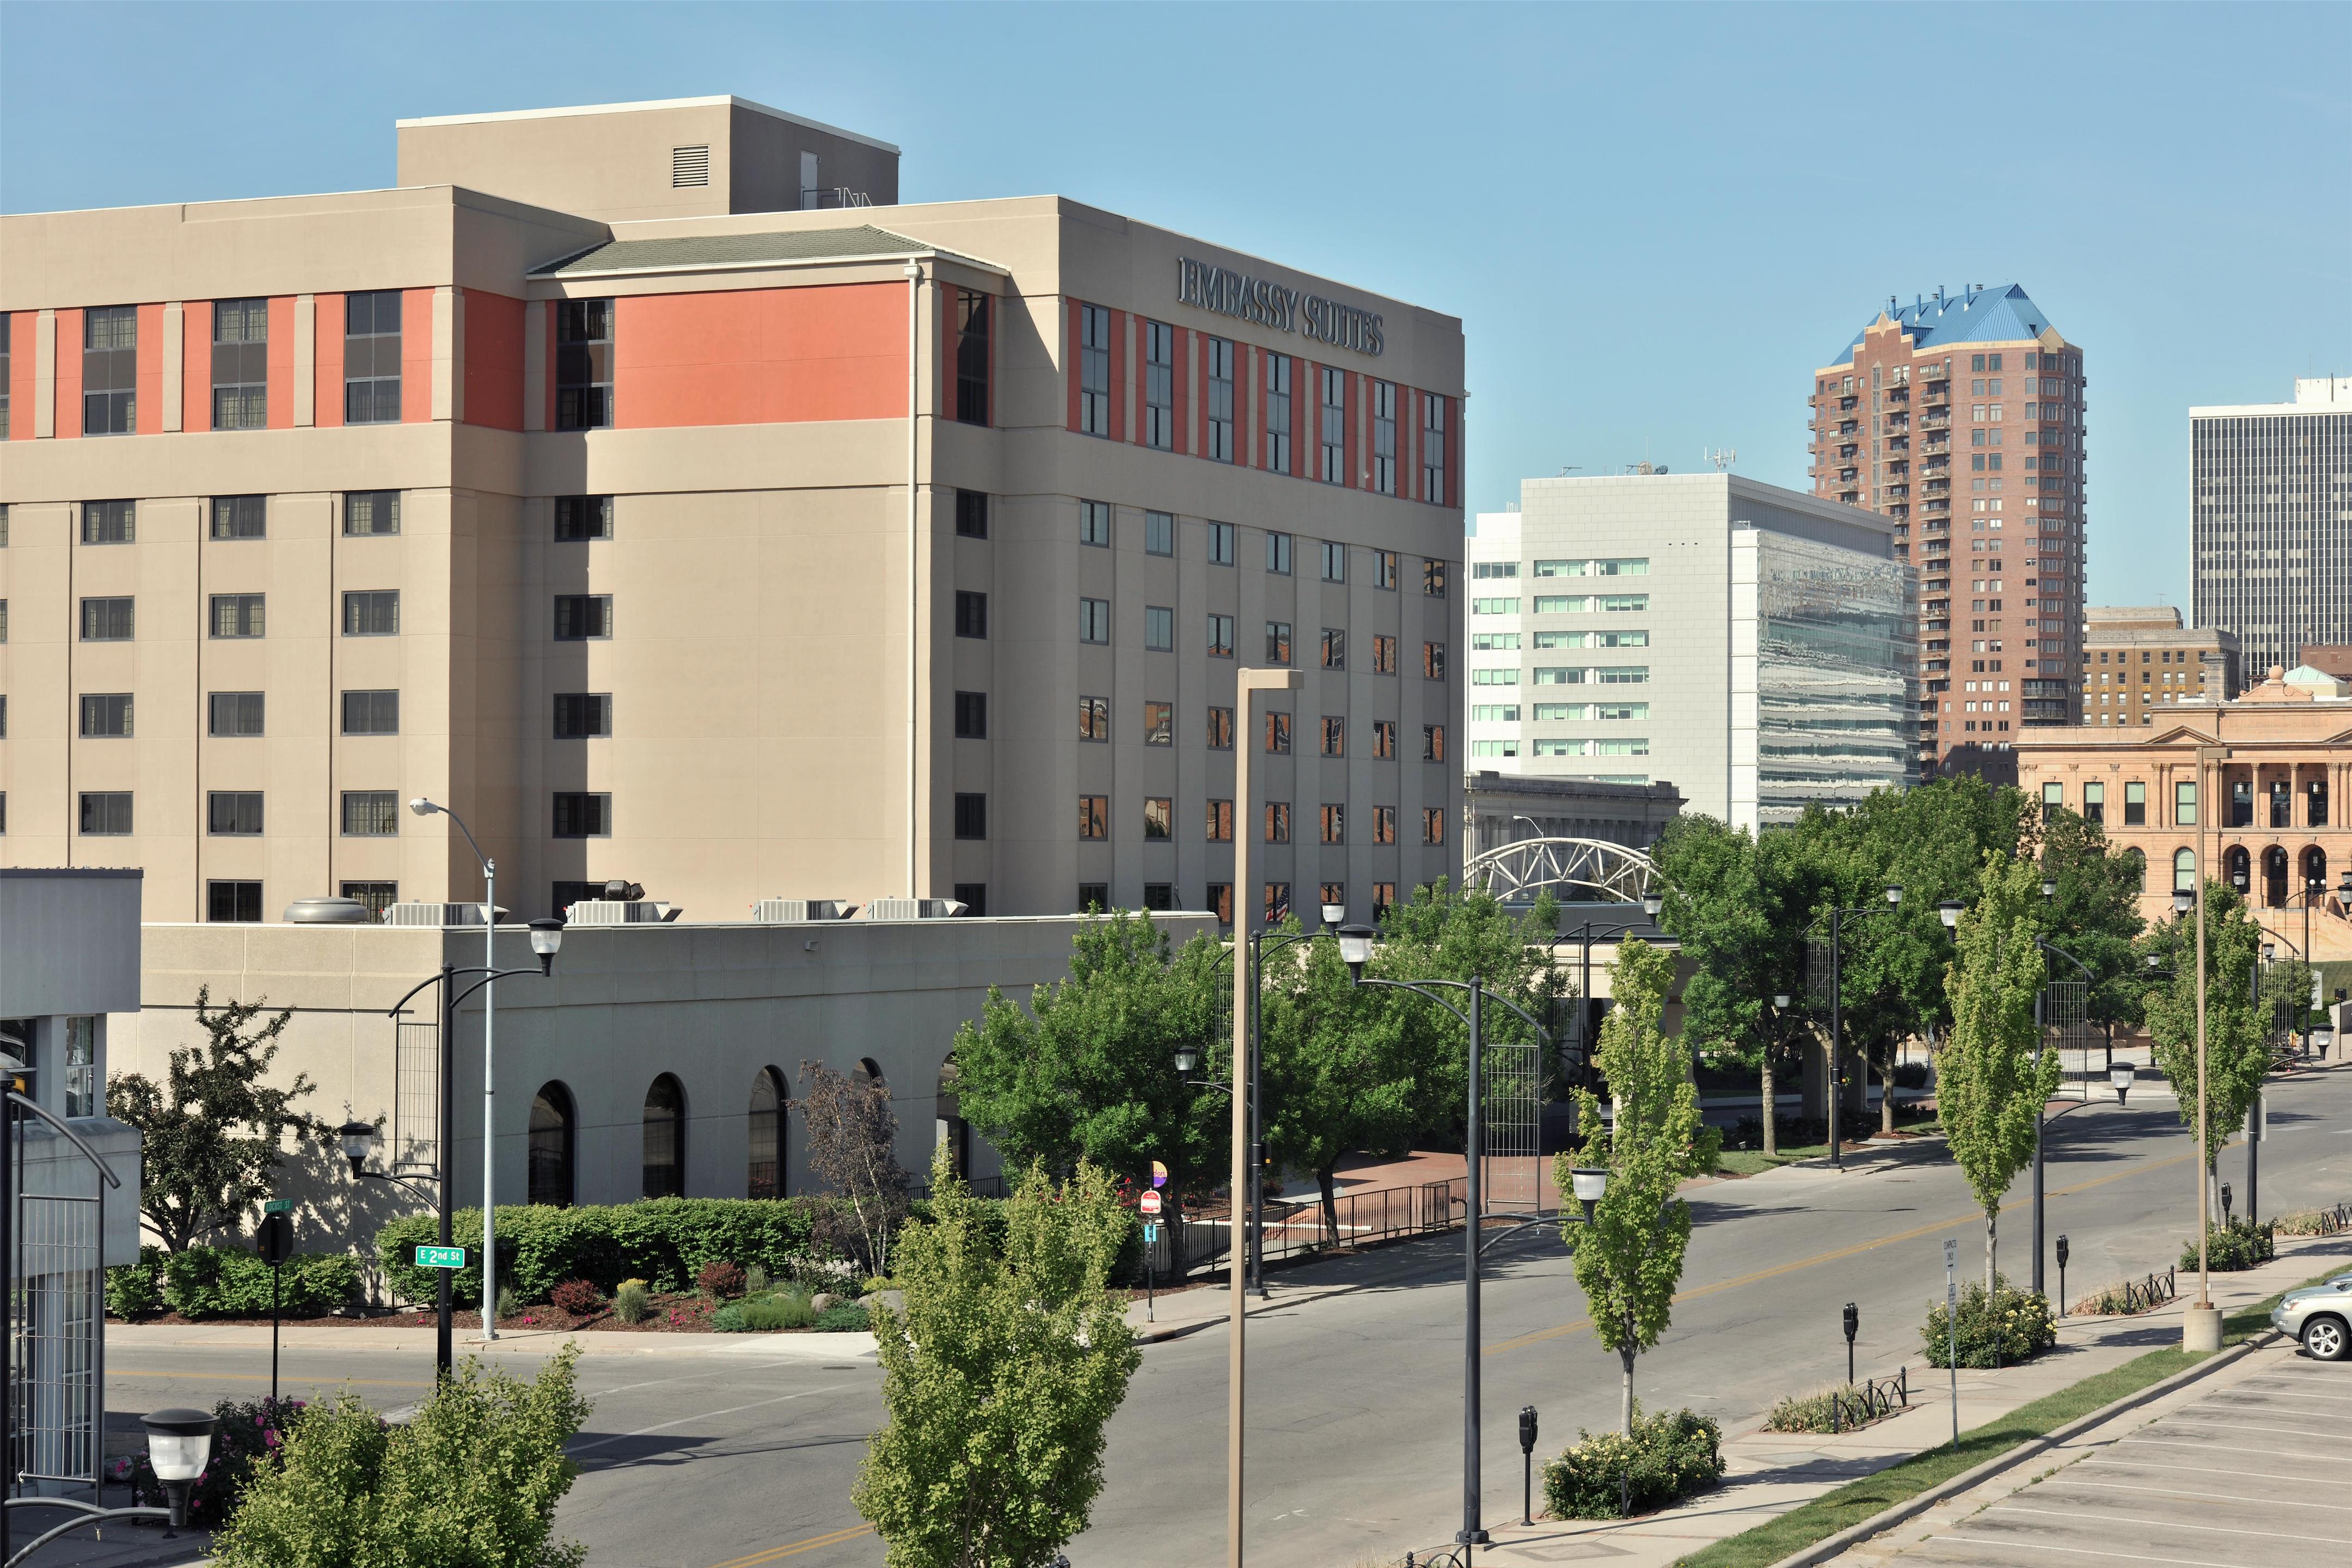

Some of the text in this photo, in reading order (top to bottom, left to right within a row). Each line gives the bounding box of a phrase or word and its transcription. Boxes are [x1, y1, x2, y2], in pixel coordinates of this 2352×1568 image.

[1178, 257, 1384, 357] EMBASSY SUITES
[267, 1200, 290, 1211] LOCUST ST
[420, 1250, 460, 1263] E 2nd St
